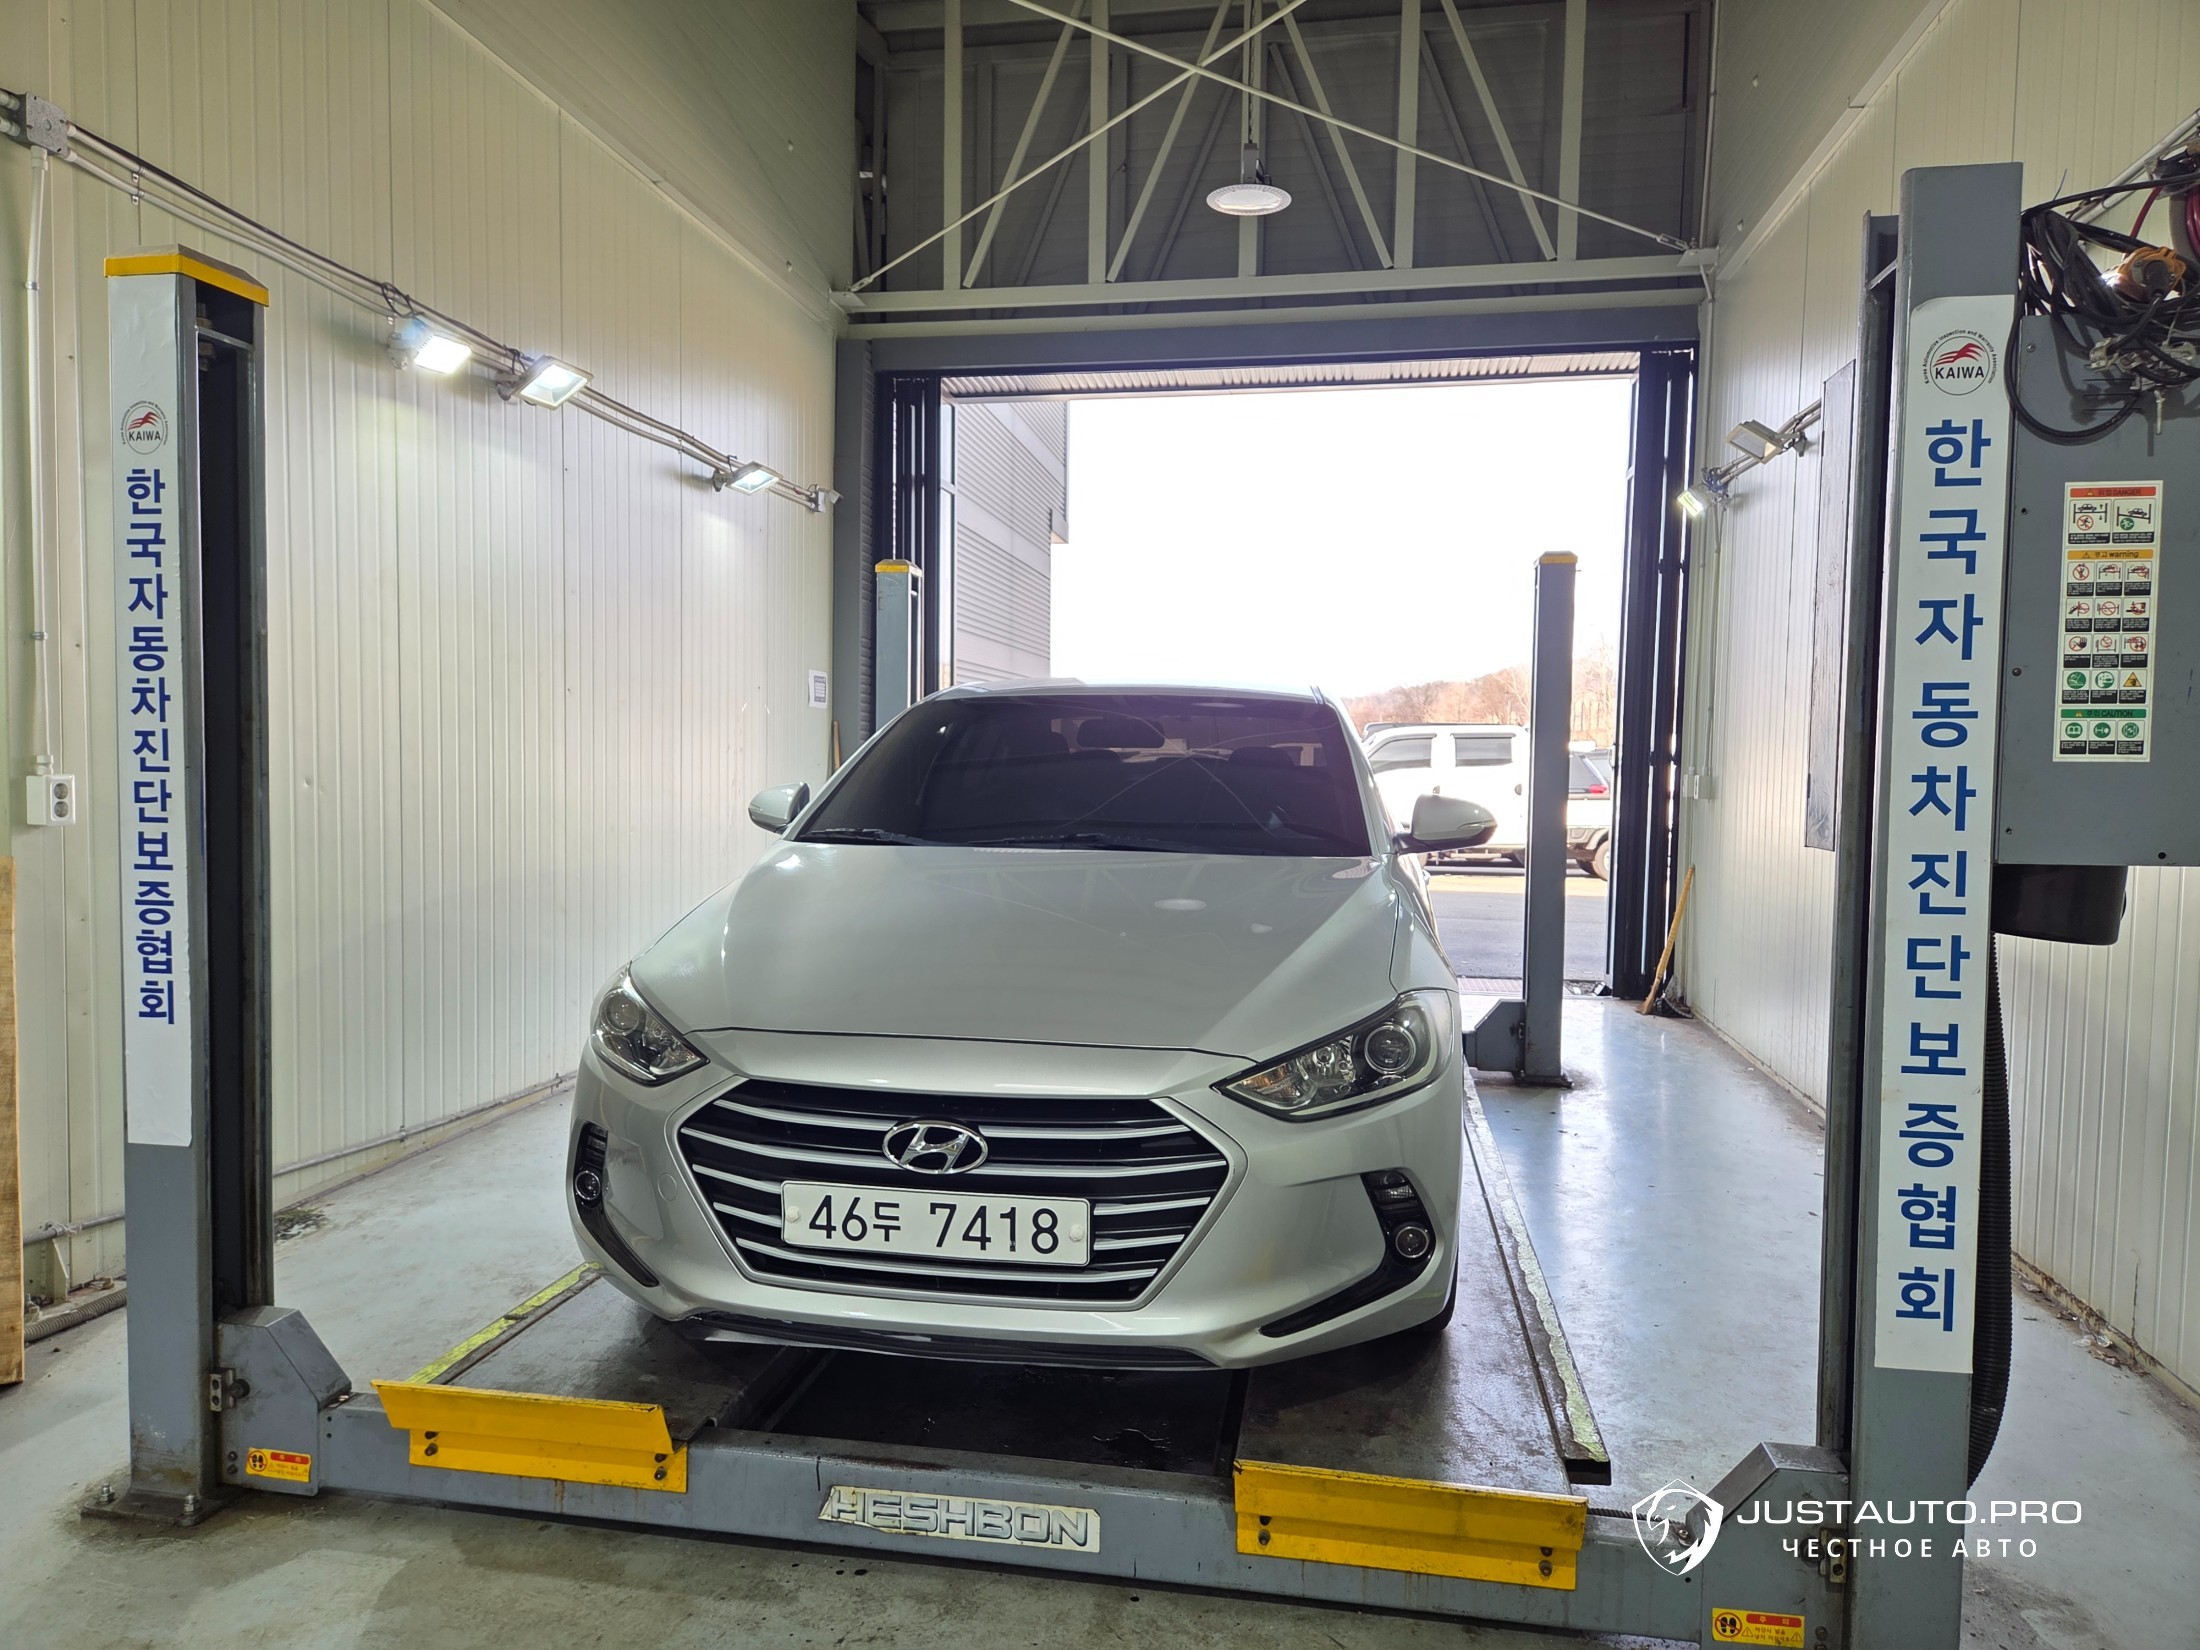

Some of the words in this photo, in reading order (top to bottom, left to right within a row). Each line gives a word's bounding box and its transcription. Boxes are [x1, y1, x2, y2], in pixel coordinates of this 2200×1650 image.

[1935, 366, 1984, 379] KAIWA
[129, 430, 161, 441] KAIWA
[2109, 550, 2139, 558] warning
[126, 469, 174, 1024] 한국자동차진단보증협회
[1896, 419, 1991, 1331] 한국자동차진단보증협회
[809, 1194, 901, 1242] 46두
[929, 1202, 1059, 1254] 7418
[829, 1489, 1088, 1546] HESHBON
